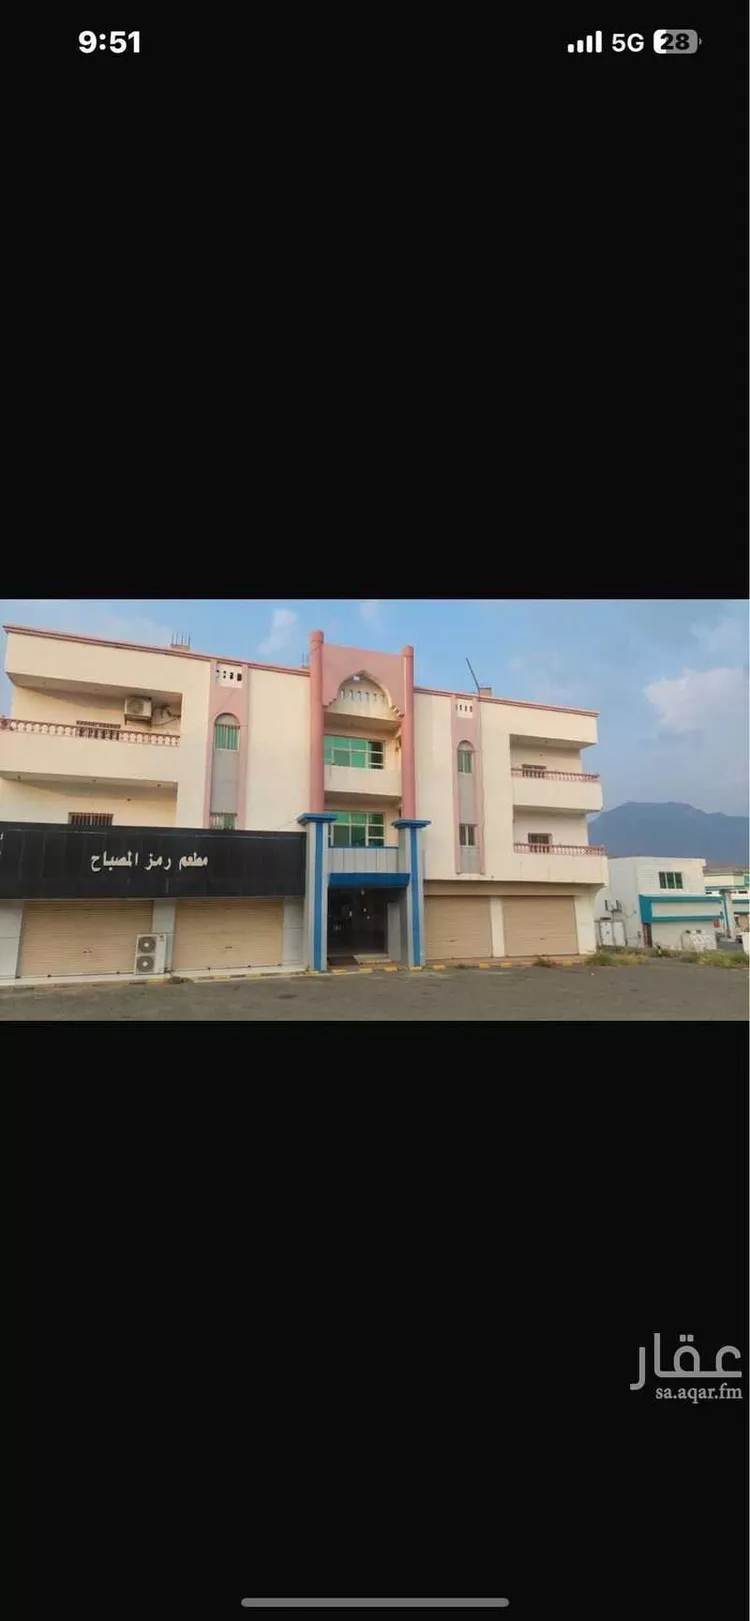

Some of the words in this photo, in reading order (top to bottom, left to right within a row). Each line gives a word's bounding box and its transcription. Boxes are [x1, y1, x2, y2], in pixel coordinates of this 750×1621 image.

[91, 850, 139, 872] المصباح
[144, 852, 172, 871] رمز
[179, 851, 208, 871] مطعم
